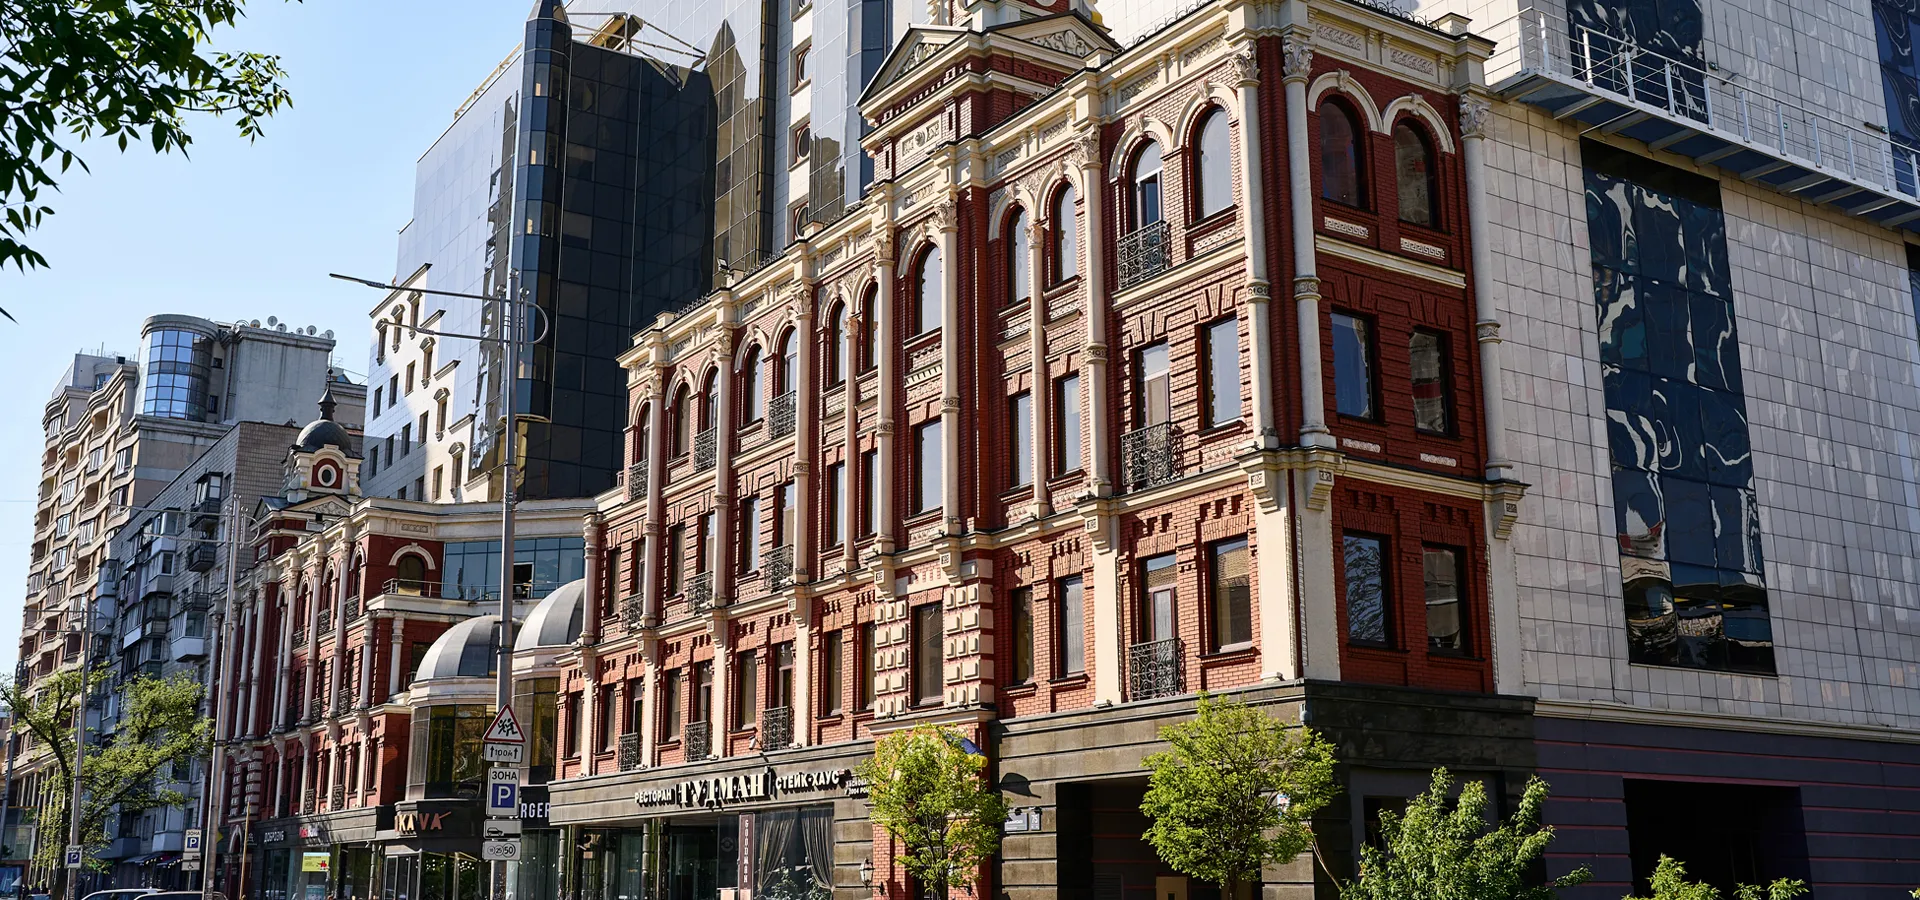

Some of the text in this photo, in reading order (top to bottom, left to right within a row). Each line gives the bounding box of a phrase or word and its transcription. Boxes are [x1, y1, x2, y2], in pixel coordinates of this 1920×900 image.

[491, 770, 518, 780] ЗОНА
[634, 788, 672, 803] РЕСТОРАН
[679, 773, 765, 809] ГУДМАН
[521, 802, 550, 818] RGER
[504, 845, 514, 854] 50
